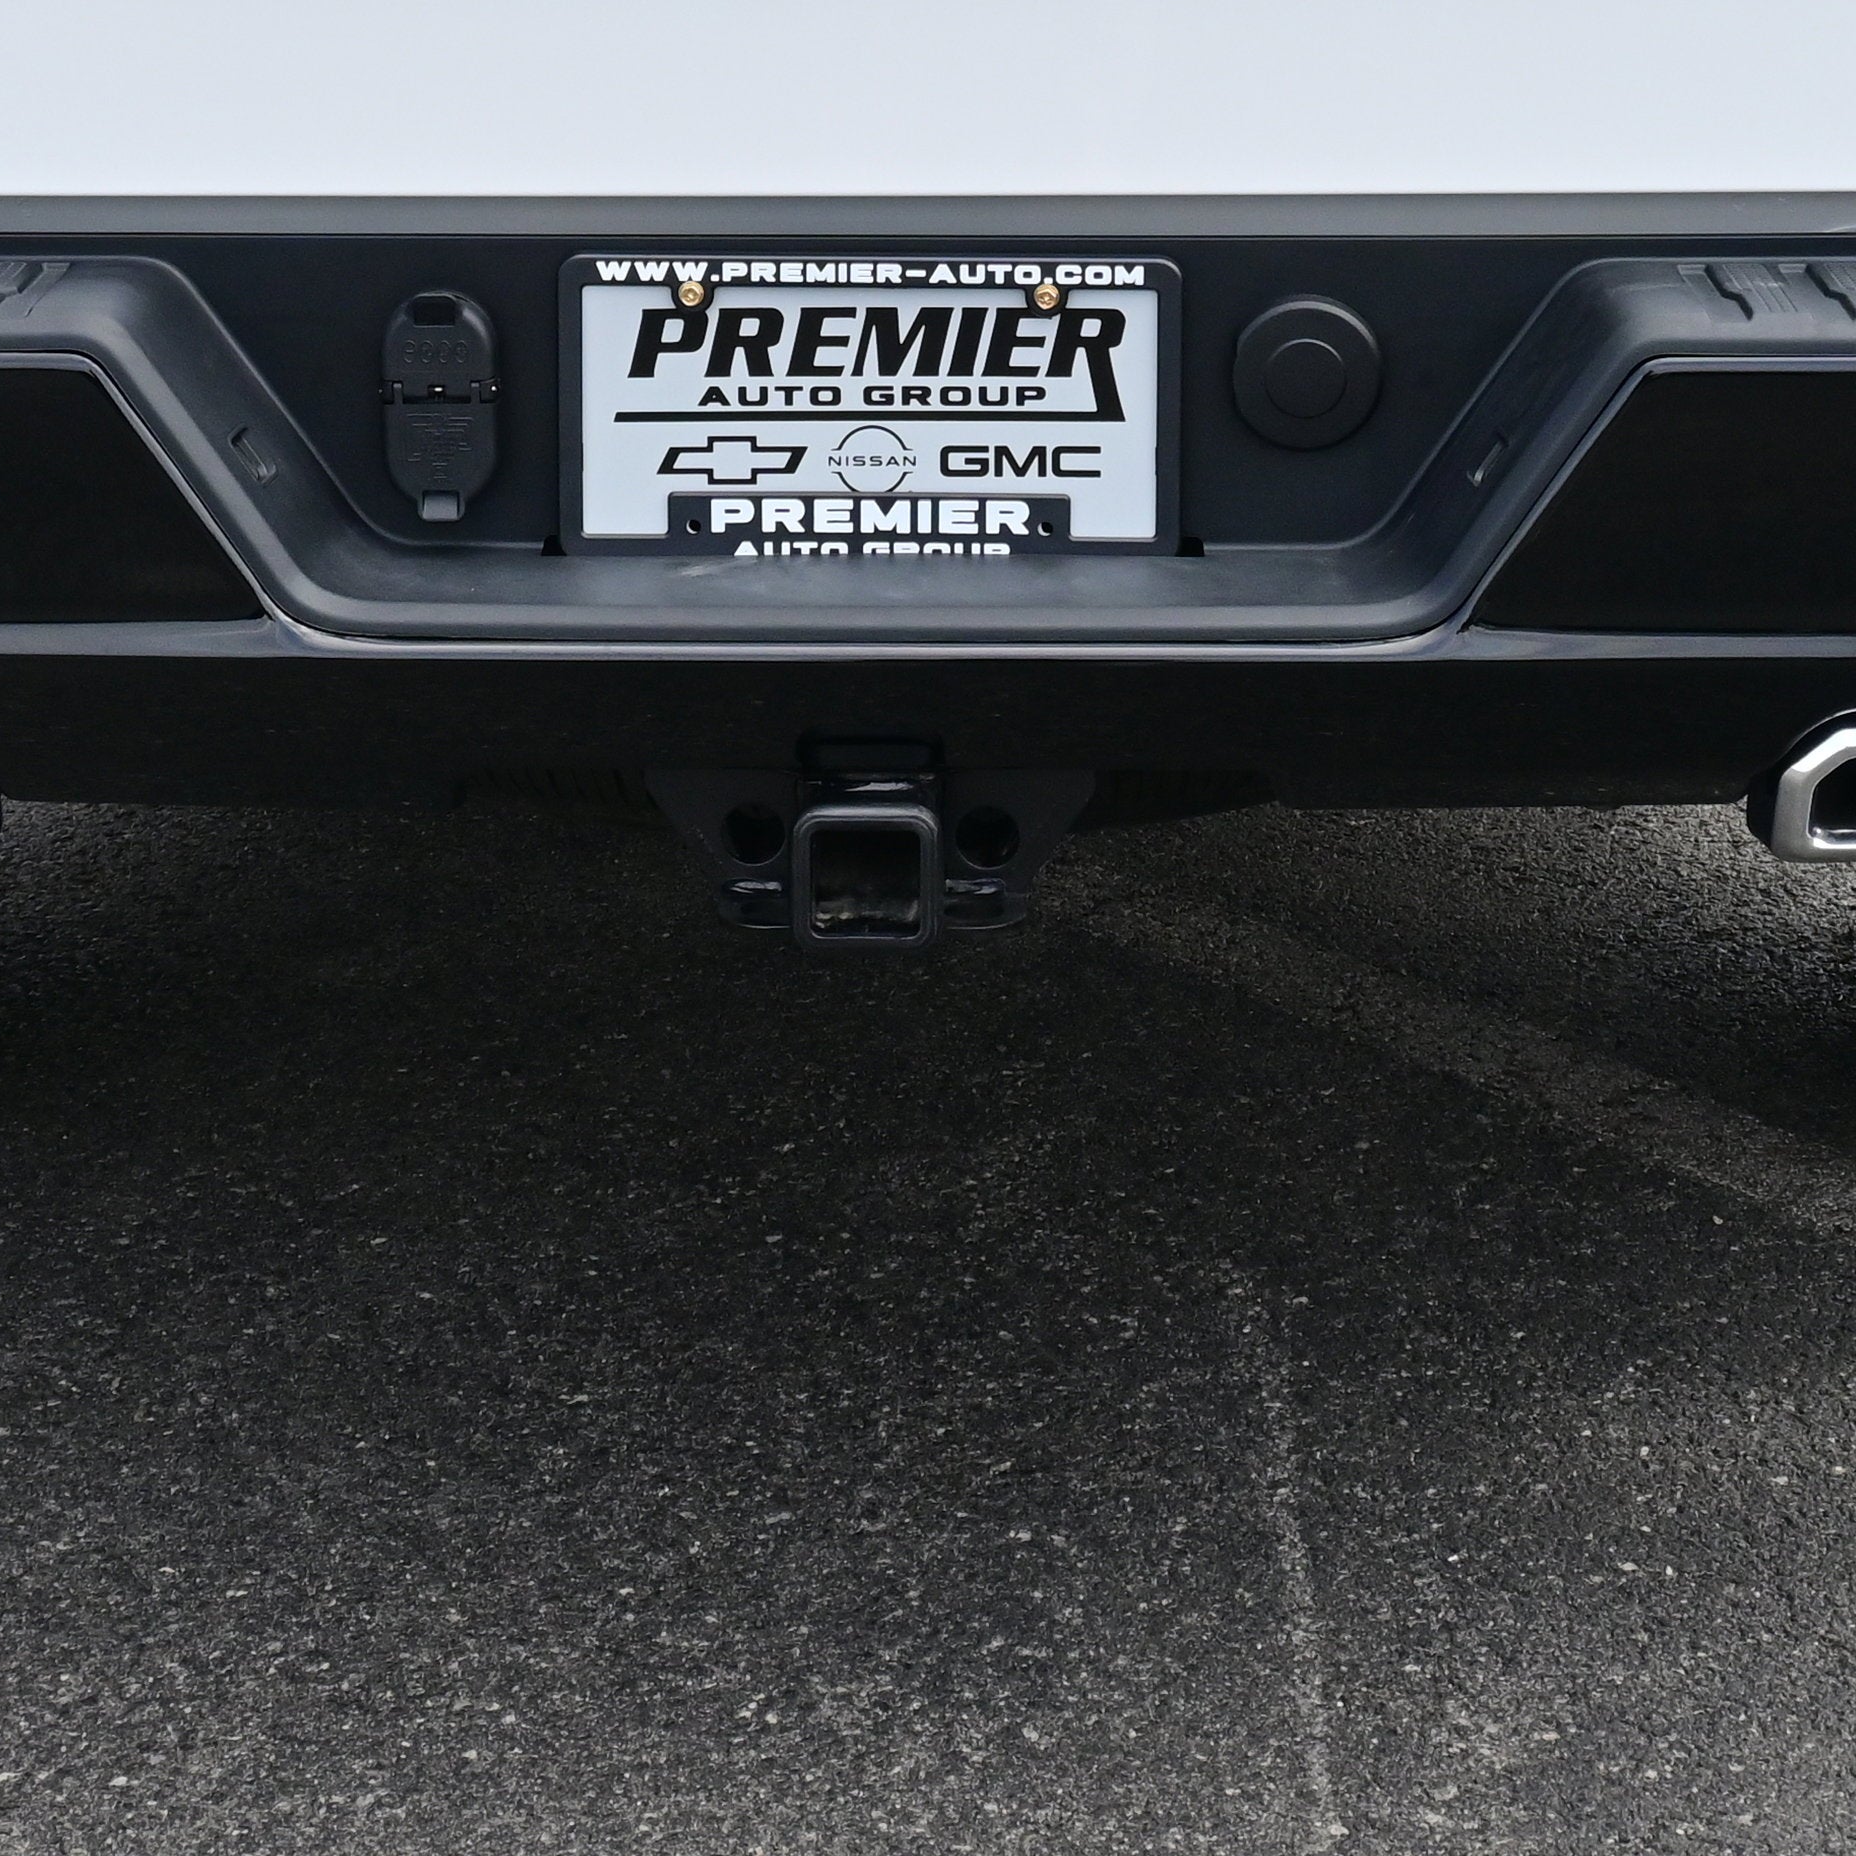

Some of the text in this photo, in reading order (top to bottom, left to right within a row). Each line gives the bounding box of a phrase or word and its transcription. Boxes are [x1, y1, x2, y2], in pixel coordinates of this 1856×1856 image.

[595, 261, 1145, 286] WWW.PREMIER-AUTO.COM
[627, 306, 1127, 384] PREMIER
[697, 385, 1047, 408] AUTO GROUP
[827, 455, 918, 467] NISSAN
[939, 445, 1102, 478] GMC
[710, 498, 1030, 536] PREMIER
